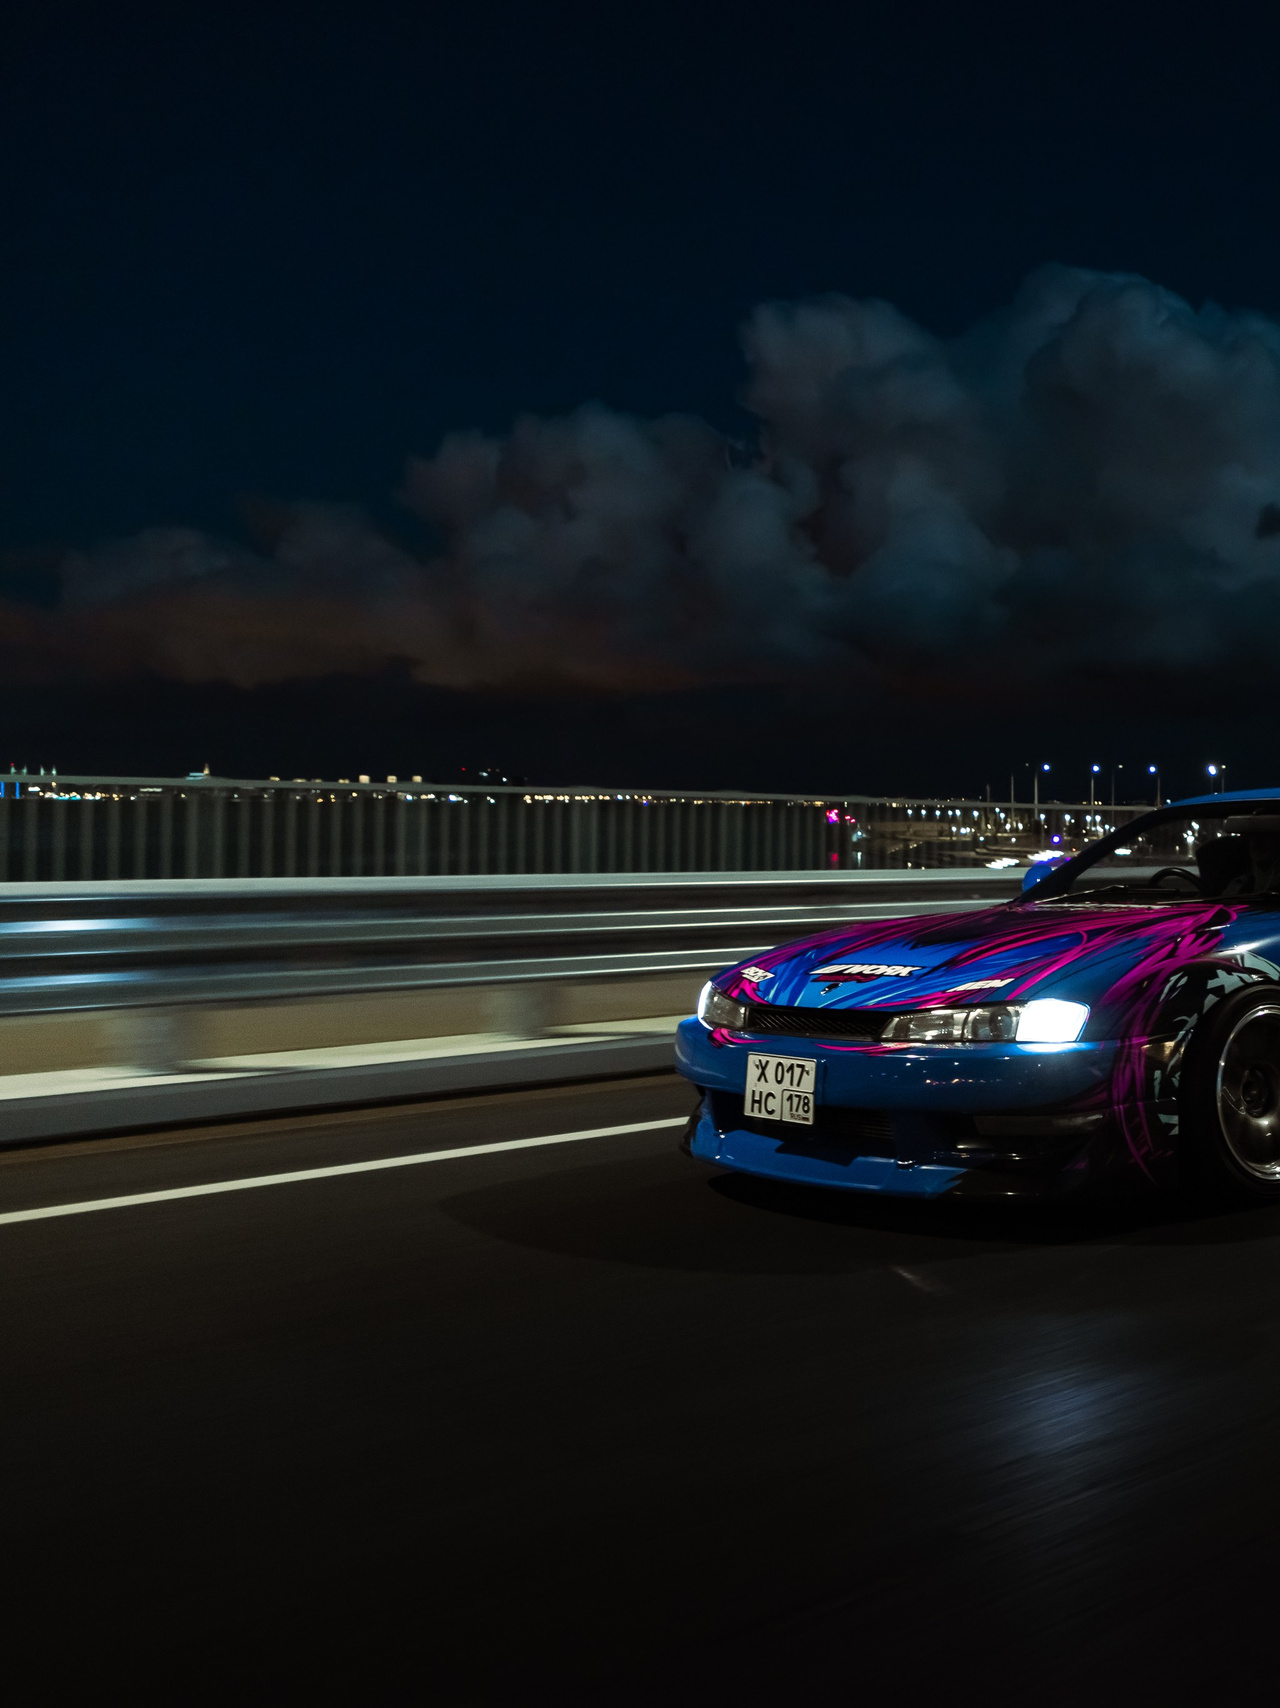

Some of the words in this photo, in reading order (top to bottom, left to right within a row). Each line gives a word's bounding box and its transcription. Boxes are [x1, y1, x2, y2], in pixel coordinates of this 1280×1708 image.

[843, 964, 922, 977] WORK
[774, 1061, 806, 1088] 017
[786, 1093, 811, 1114] 178
